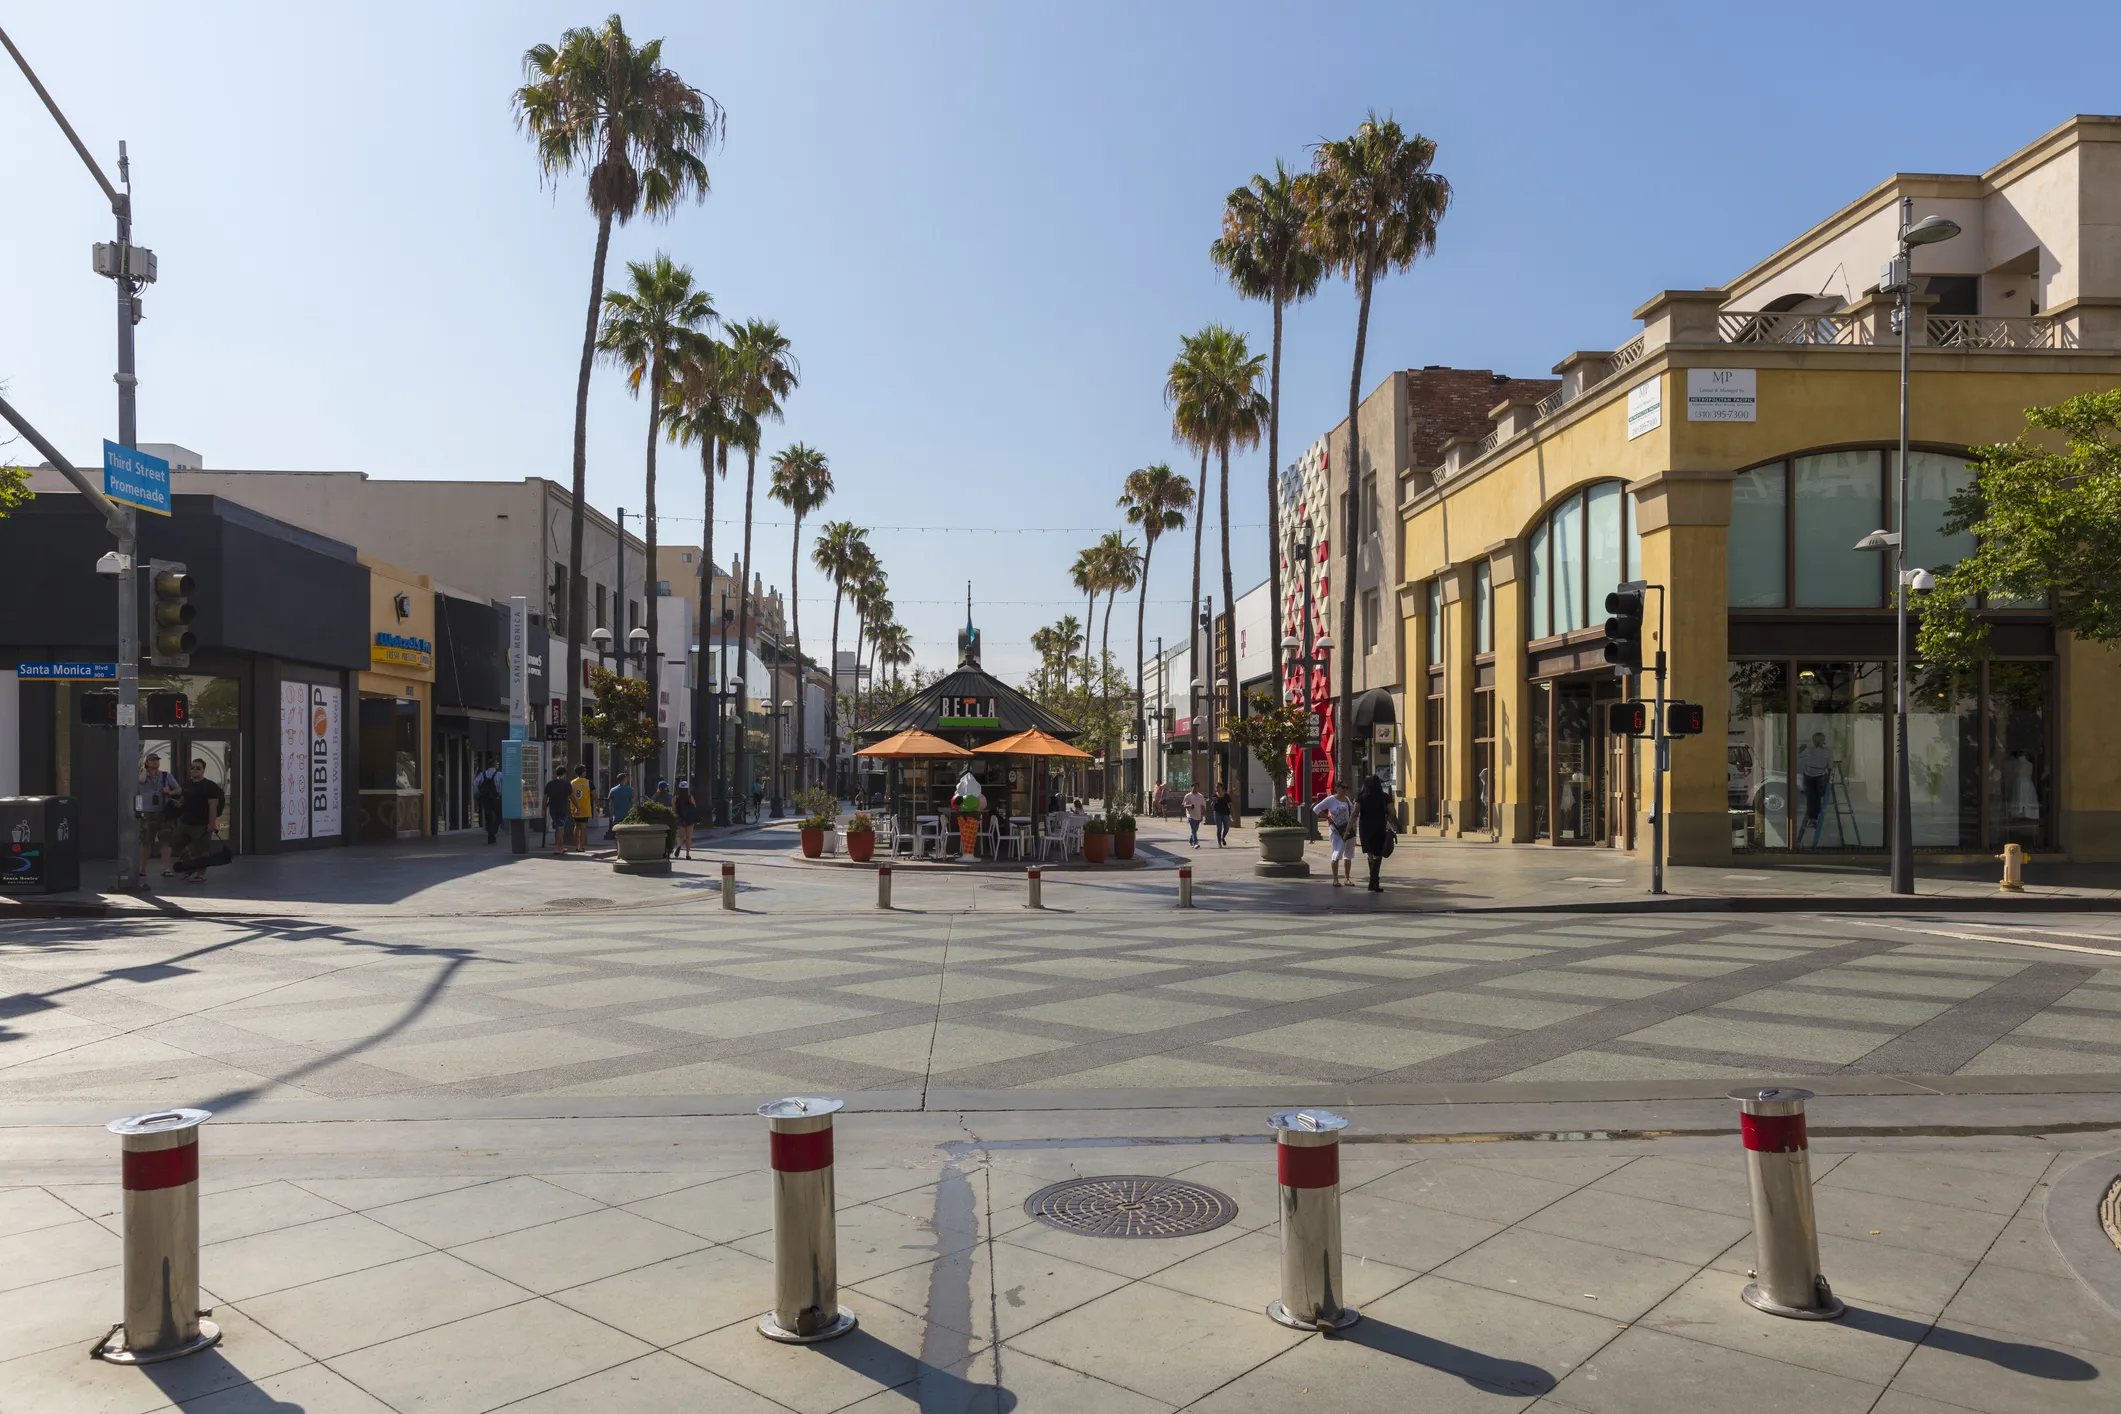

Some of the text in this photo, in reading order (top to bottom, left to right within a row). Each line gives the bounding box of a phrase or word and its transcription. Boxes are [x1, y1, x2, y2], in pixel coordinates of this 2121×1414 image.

[1712, 372, 1733, 384] MP
[1713, 410, 1749, 418] 395-7300
[108, 452, 165, 482] Third Street
[110, 476, 164, 503] Promenade
[20, 664, 49, 674] Santa
[54, 665, 91, 675] Monica
[175, 700, 184, 719] 6
[942, 697, 995, 717] BELLA
[1634, 710, 1641, 728] 6
[576, 790, 582, 799] 8
